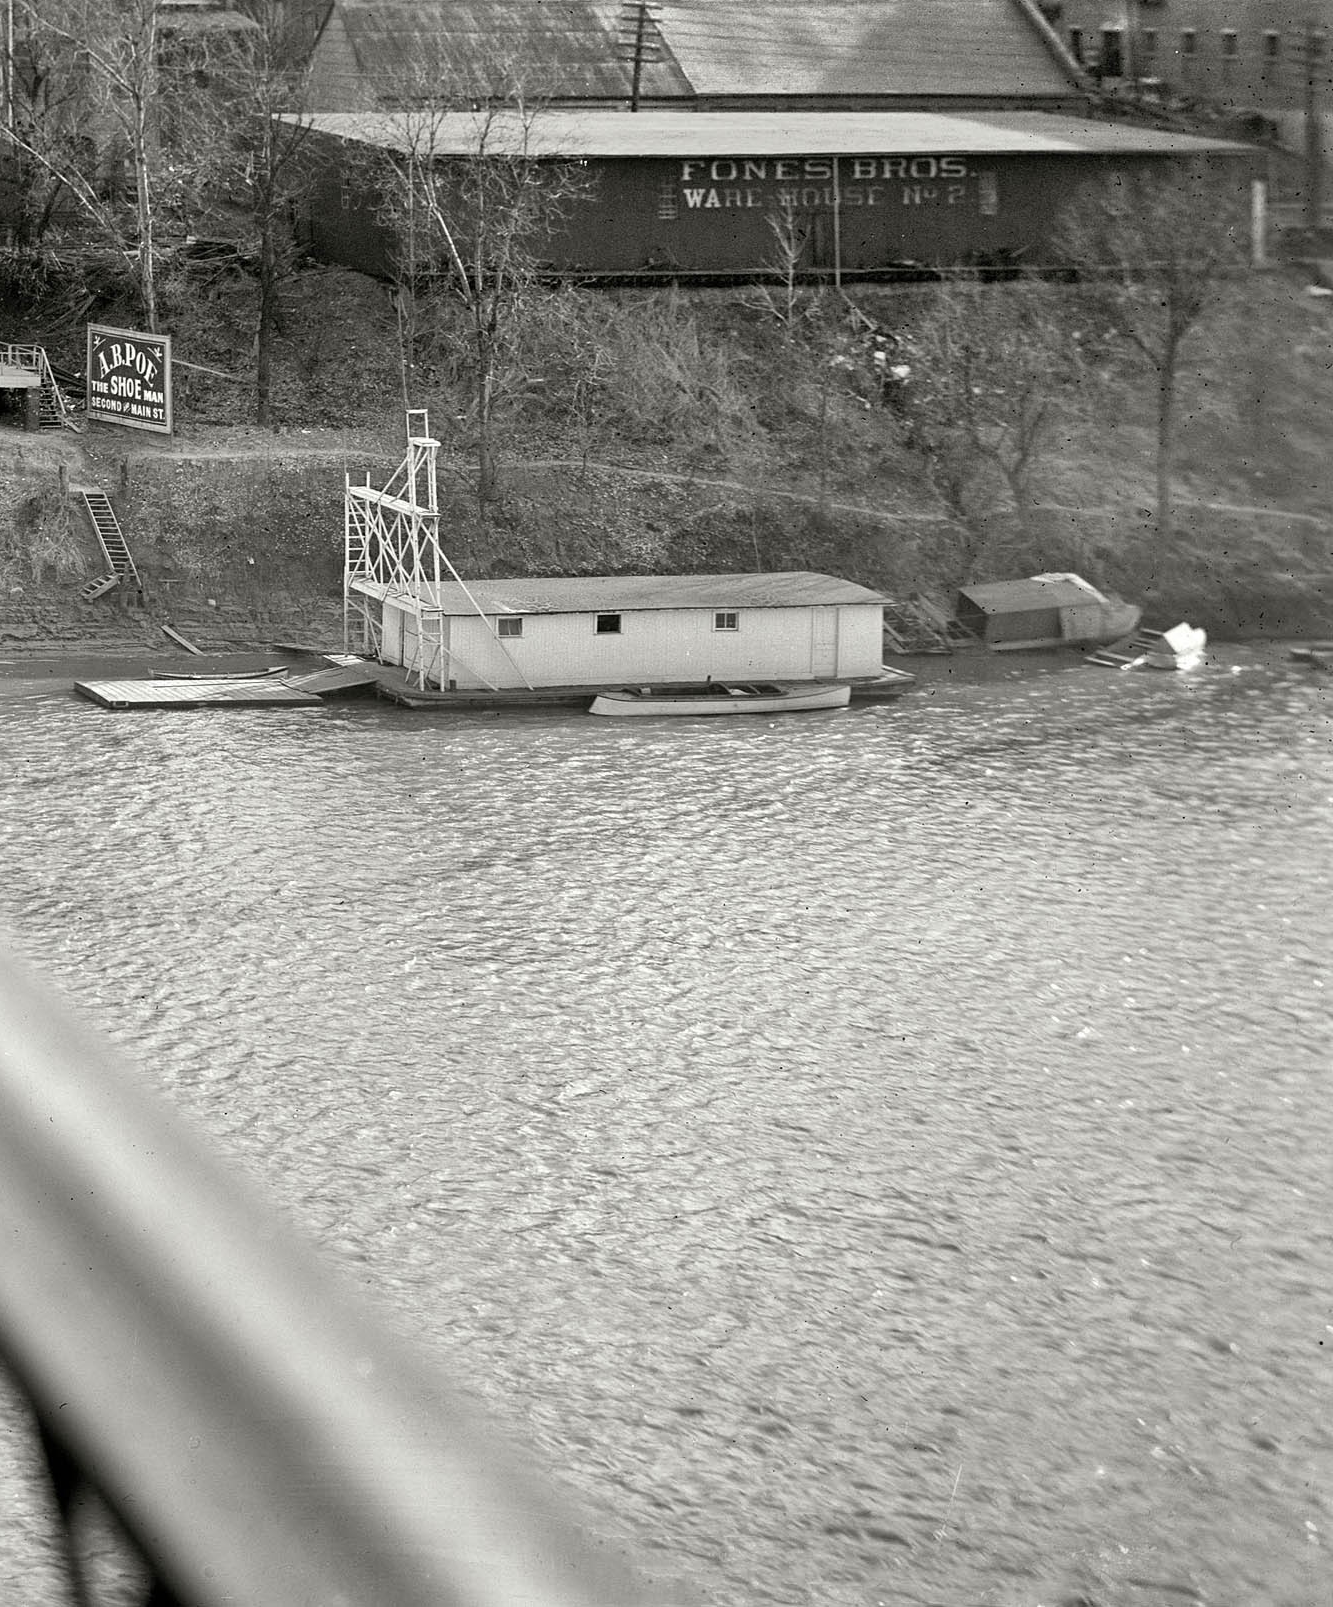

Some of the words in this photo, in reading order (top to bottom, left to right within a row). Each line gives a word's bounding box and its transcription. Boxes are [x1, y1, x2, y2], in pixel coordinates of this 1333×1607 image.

[681, 159, 834, 181] FONES
[853, 157, 978, 180] BROS.
[91, 380, 109, 394] THE
[110, 375, 142, 400] SHOE
[143, 389, 164, 404] MAN
[91, 396, 122, 412] SECOND
[131, 403, 152, 418] MAIN
[152, 407, 166, 420] ST.
